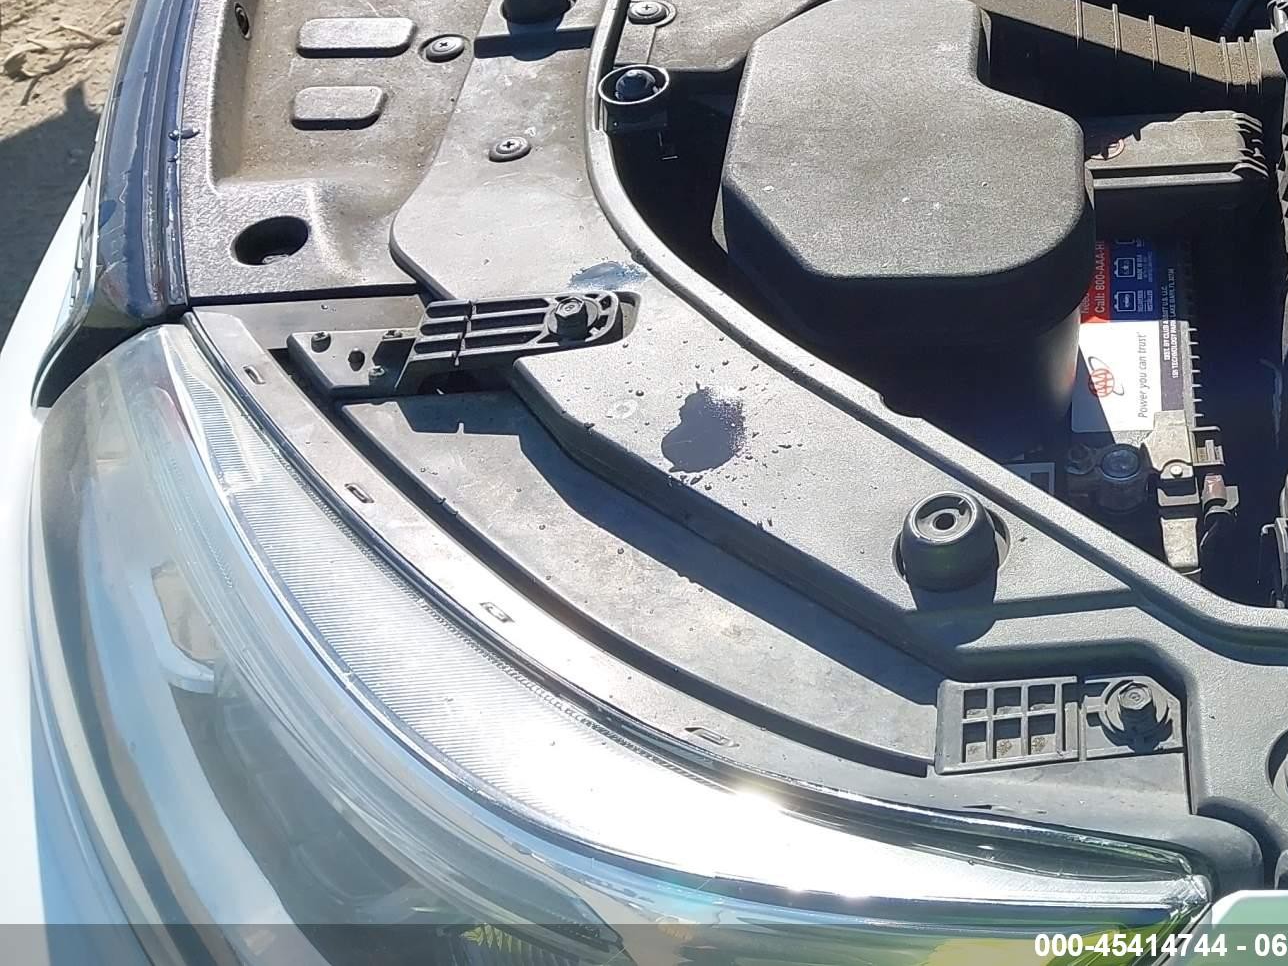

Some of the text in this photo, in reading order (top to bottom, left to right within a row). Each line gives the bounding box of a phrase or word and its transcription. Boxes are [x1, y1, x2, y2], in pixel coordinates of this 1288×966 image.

[1094, 292, 1105, 313] Call:
[1139, 356, 1147, 371] can
[1139, 373, 1150, 390] you
[1138, 390, 1148, 418] Power
